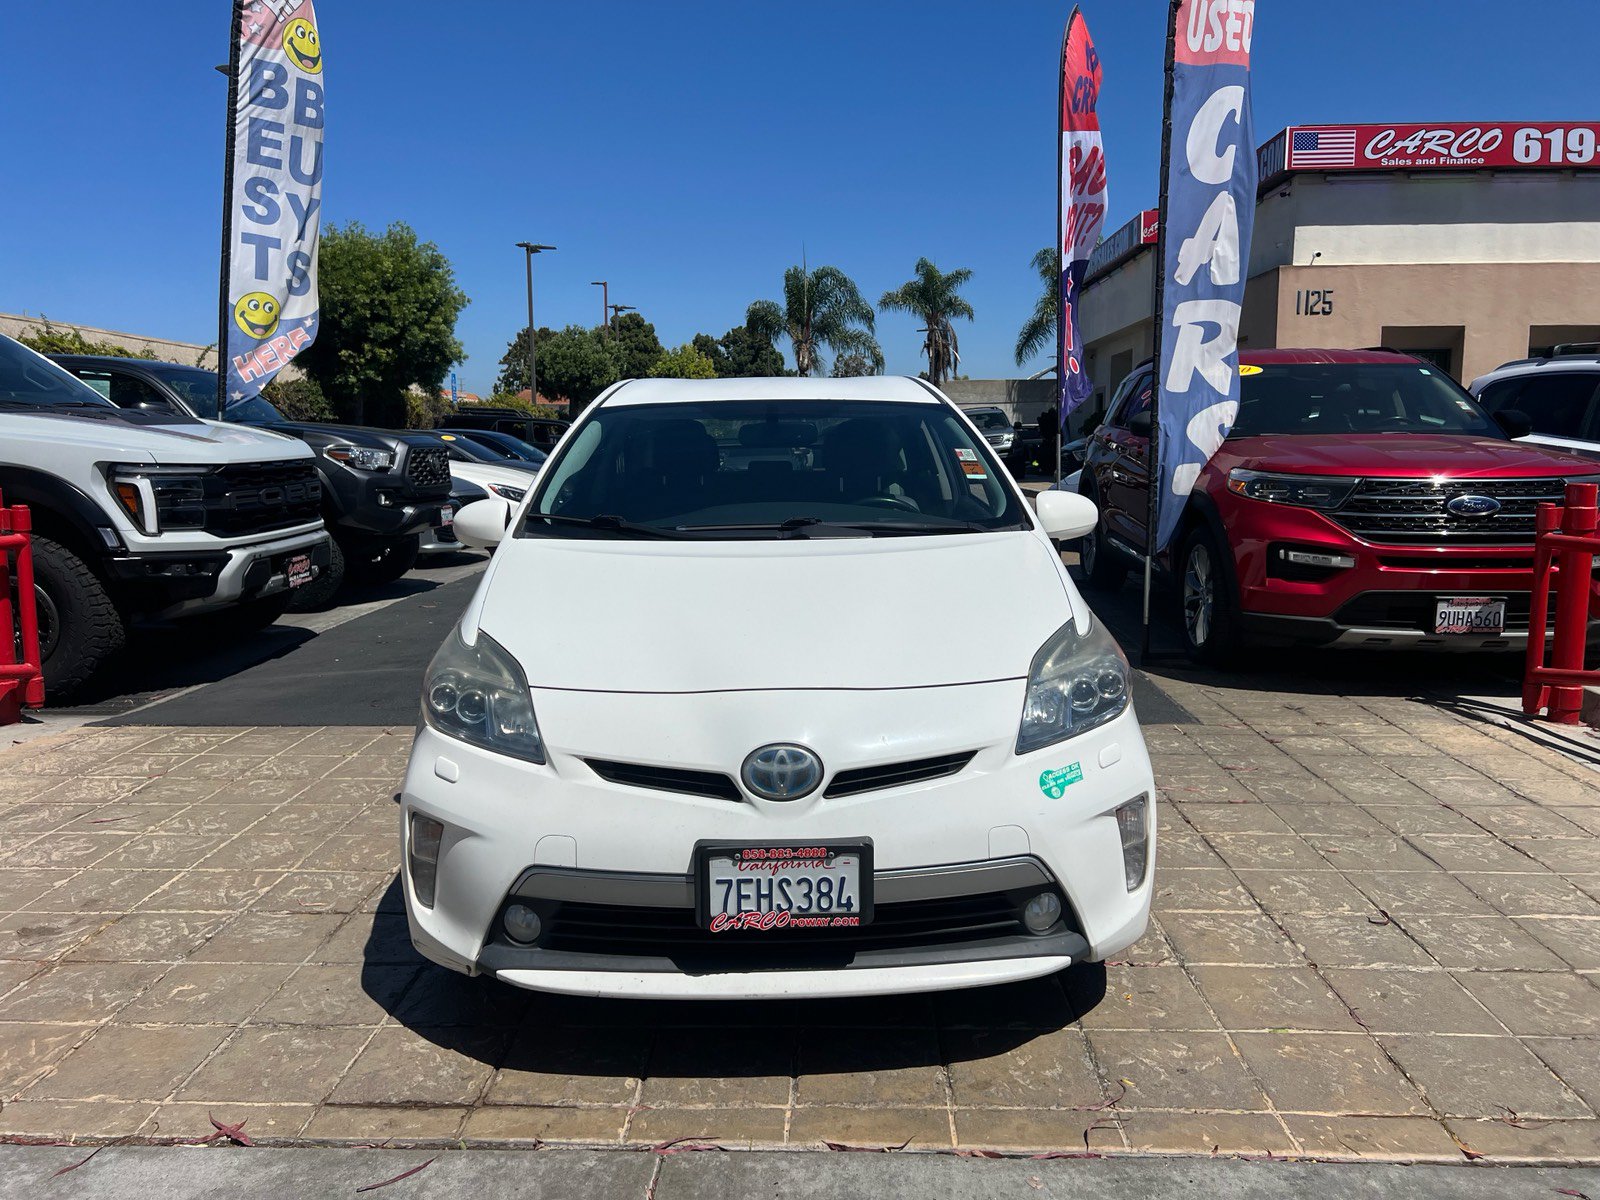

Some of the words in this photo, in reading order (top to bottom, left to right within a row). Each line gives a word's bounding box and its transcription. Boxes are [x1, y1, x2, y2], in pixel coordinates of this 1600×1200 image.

[1363, 127, 1503, 160] CARCO
[242, 58, 289, 281] BEST
[1381, 157, 1412, 166] Sales
[1415, 157, 1436, 165] and
[1440, 156, 1485, 165] Finance
[284, 77, 324, 297] BUYS
[1296, 289, 1334, 315] 1125
[1438, 610, 1502, 627] 9UHA560
[715, 876, 854, 913] 7EHS384
[710, 910, 791, 933] CARCO
